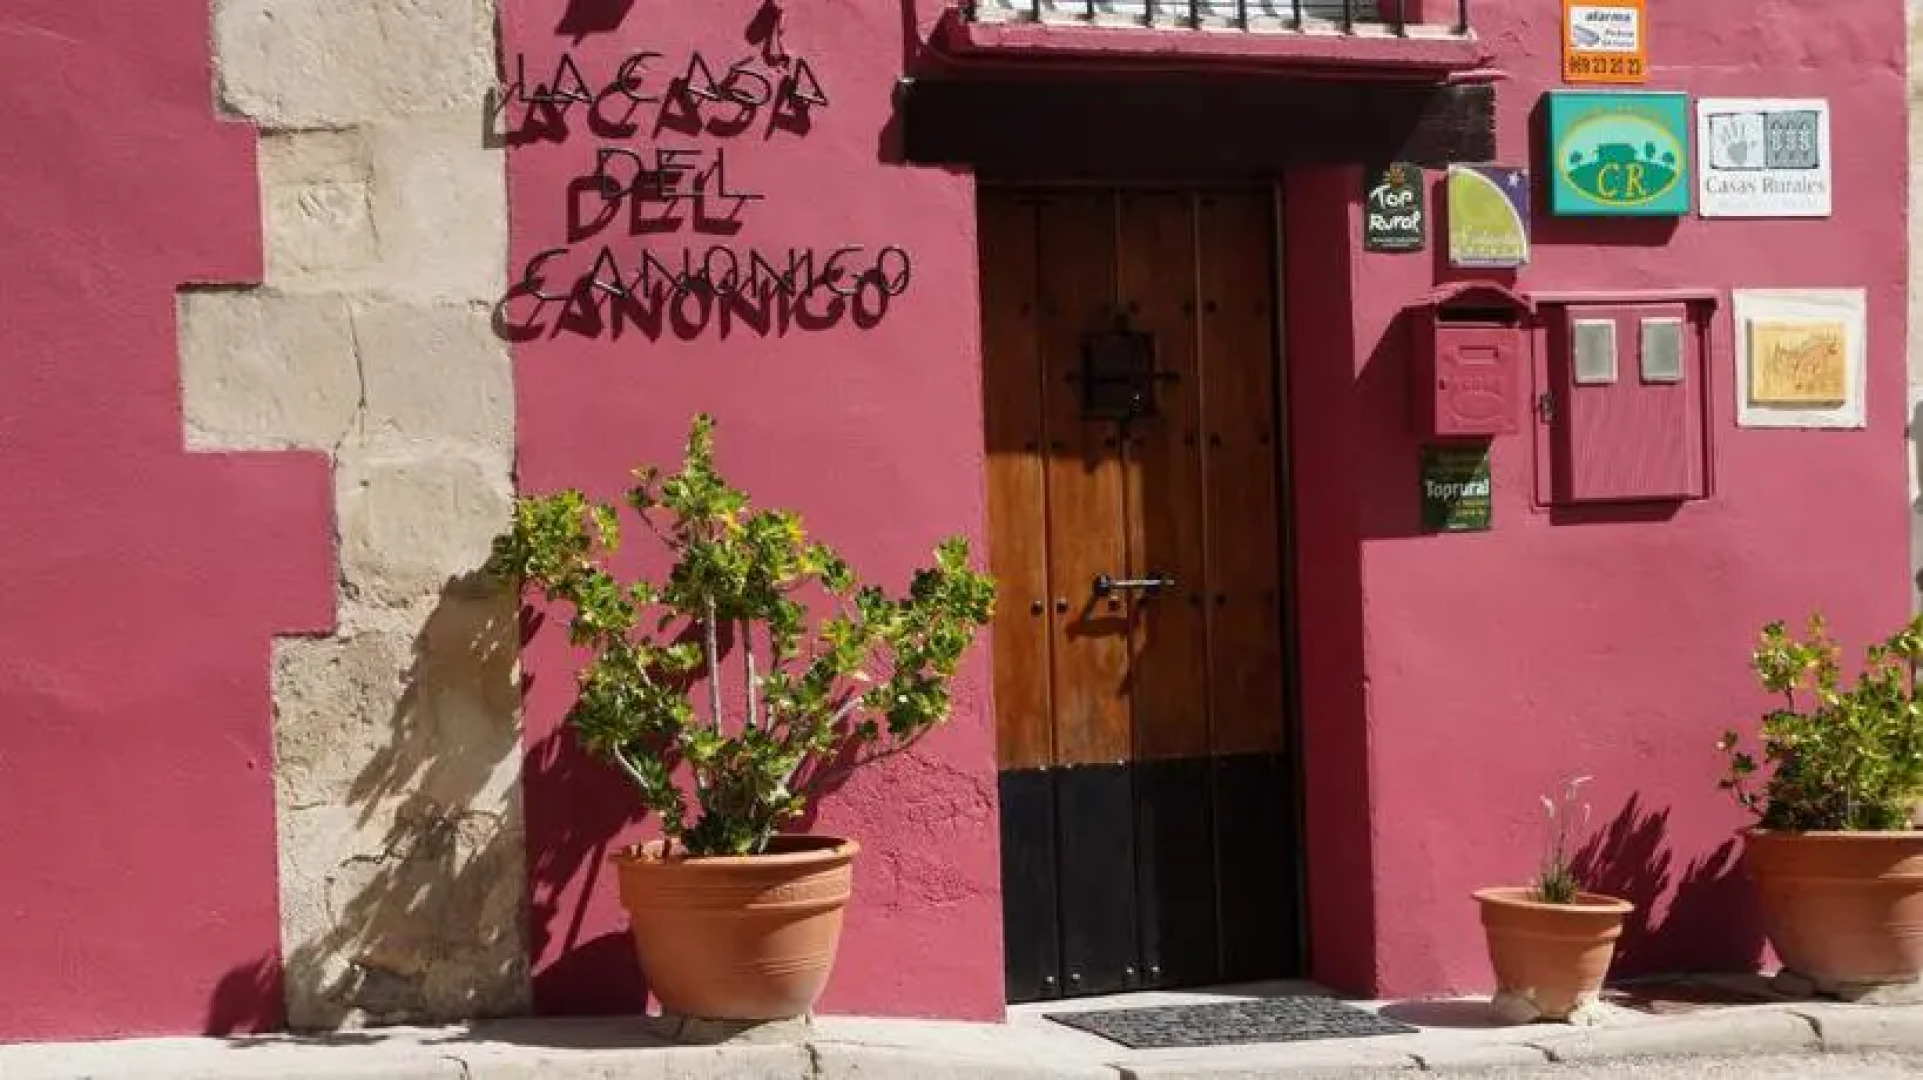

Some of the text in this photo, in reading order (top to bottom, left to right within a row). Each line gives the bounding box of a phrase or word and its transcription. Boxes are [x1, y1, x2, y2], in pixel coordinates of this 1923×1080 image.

[1598, 163, 1647, 198] CR
[1706, 175, 1825, 194] Casas Rurales
[1369, 210, 1422, 233] Rural
[1424, 478, 1490, 501] Toprural
